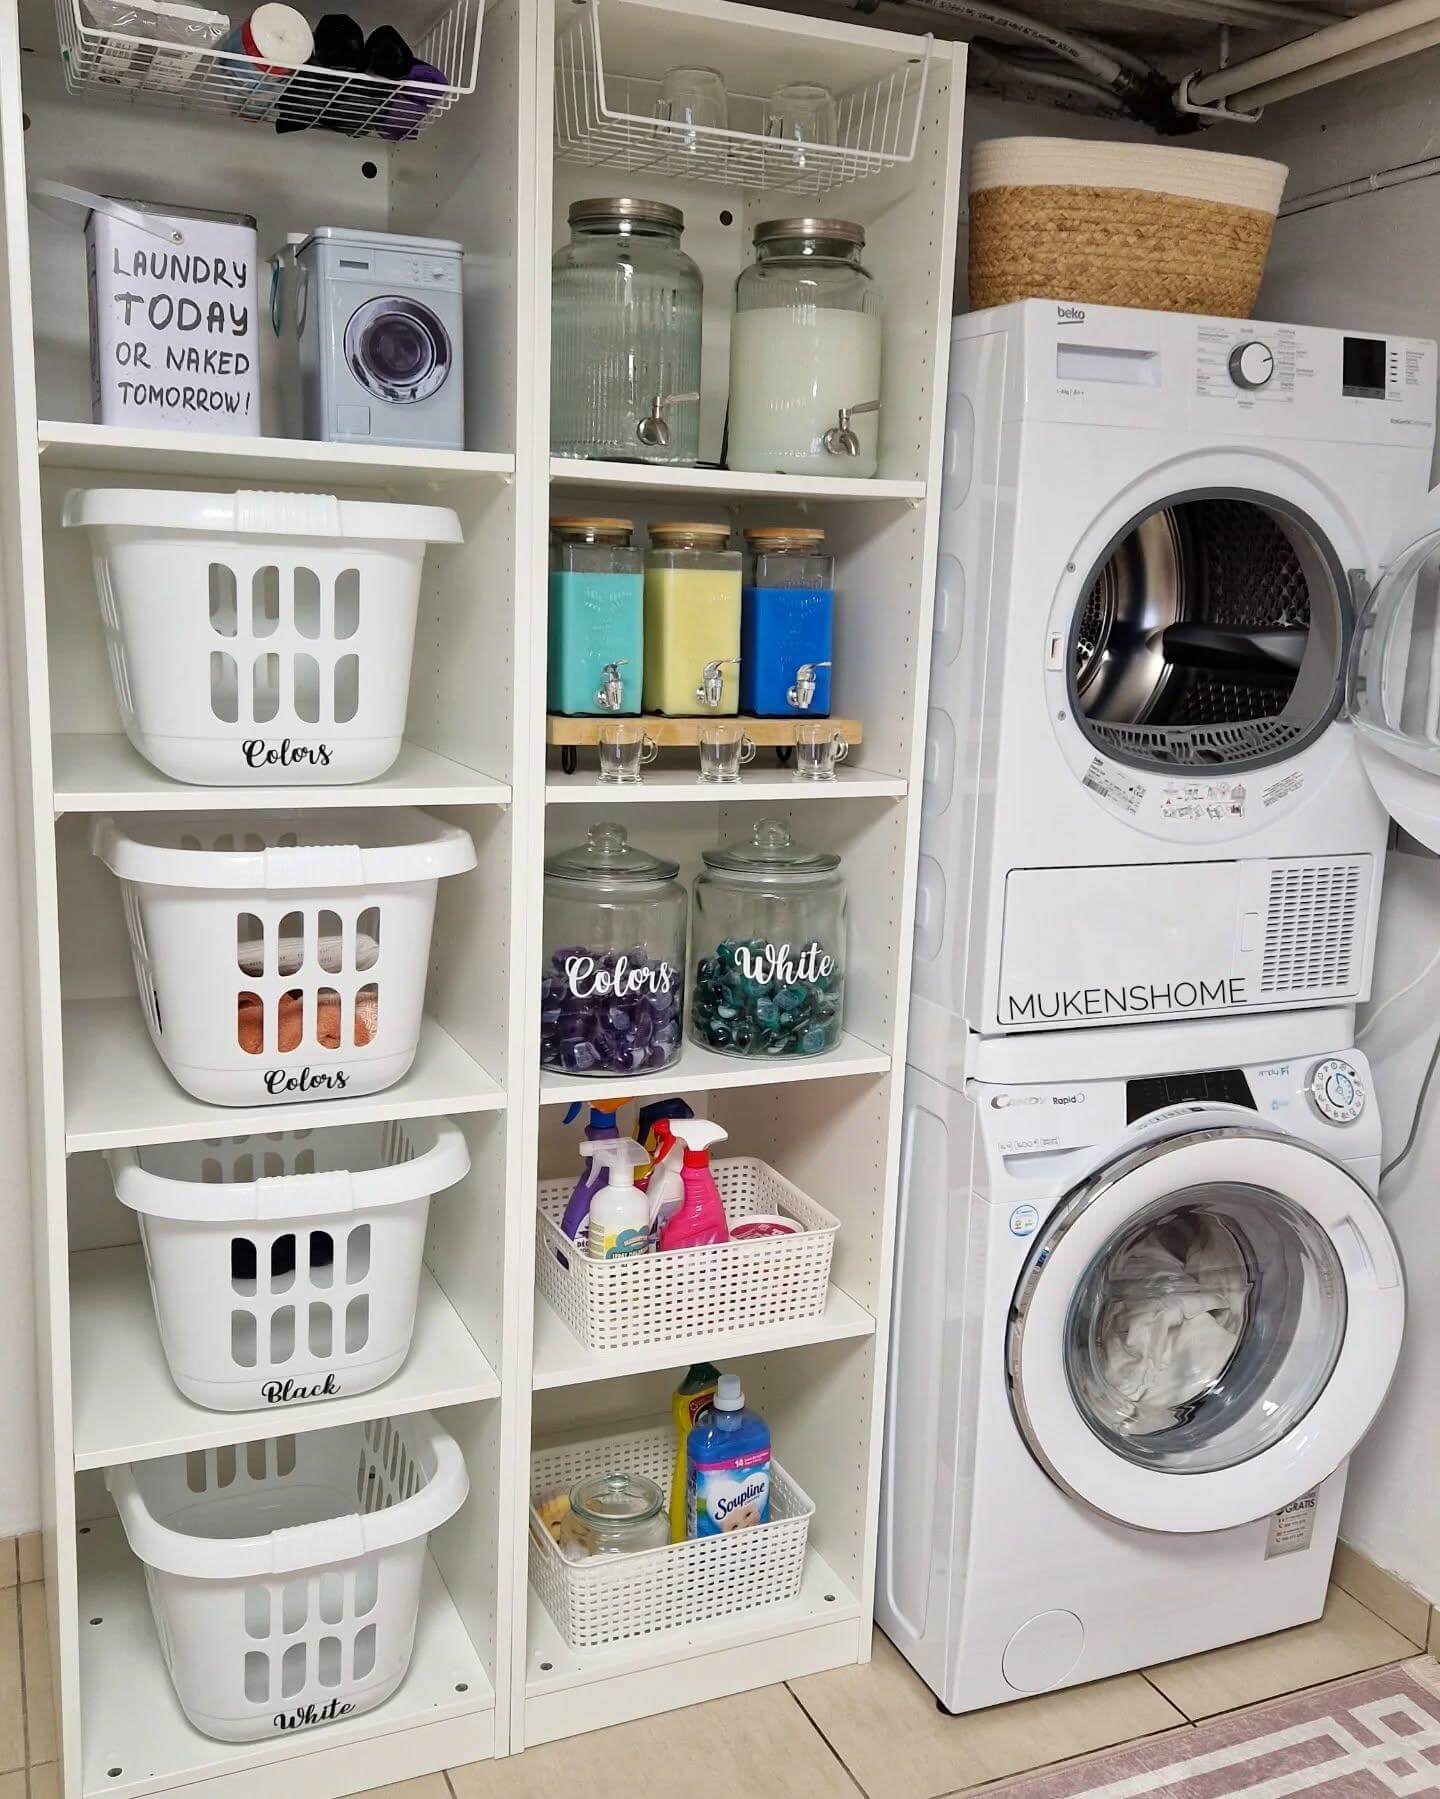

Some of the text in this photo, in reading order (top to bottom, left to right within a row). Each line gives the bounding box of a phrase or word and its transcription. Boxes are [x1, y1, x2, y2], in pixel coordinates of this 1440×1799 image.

[114, 248, 247, 288] LAUNDRY
[113, 291, 249, 336] TODAY
[1057, 306, 1086, 320] beko
[115, 341, 250, 376] OR NAKED
[117, 381, 251, 416] TOMORROW!
[242, 738, 334, 768] Colors
[565, 955, 673, 998] Colors
[734, 942, 835, 985] White
[264, 1066, 350, 1094] Colors
[261, 1373, 342, 1404] Black
[714, 1482, 765, 1521] Soupline
[273, 1697, 357, 1730] White
